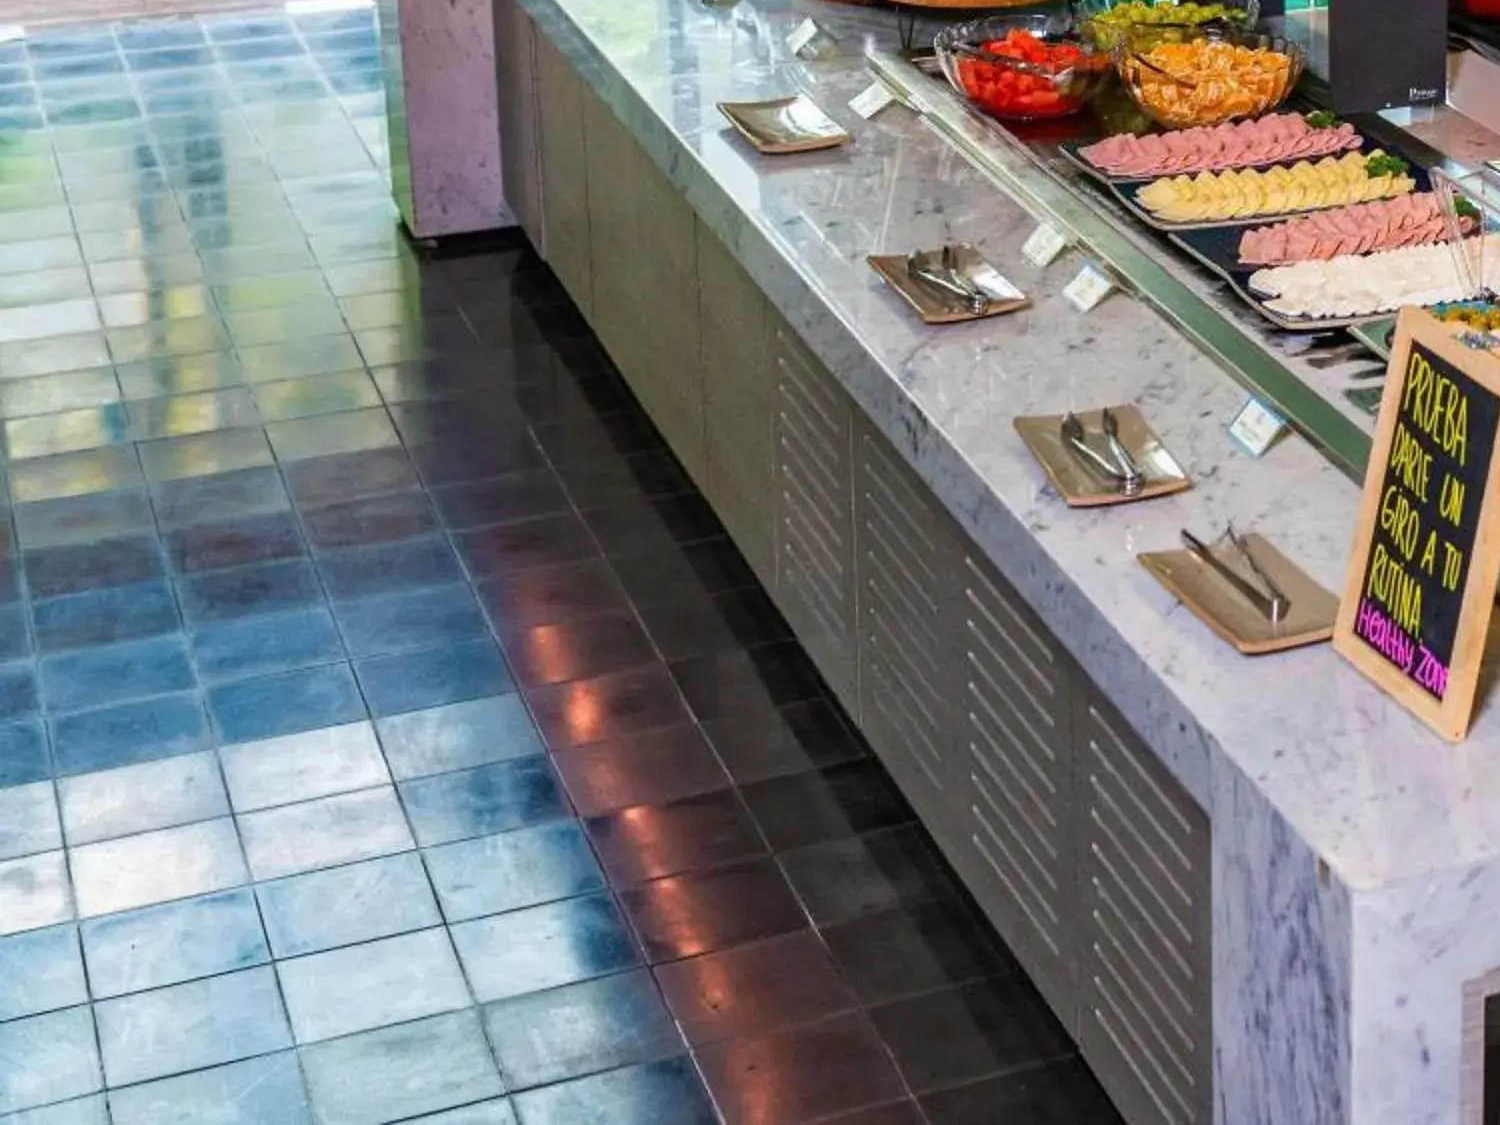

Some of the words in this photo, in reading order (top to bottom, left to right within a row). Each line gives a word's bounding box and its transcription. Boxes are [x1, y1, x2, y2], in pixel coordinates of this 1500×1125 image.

[1404, 353, 1468, 466] PRUEBA
[1391, 423, 1431, 504] DARLE
[1440, 474, 1465, 527] UN
[1420, 530, 1437, 576] A
[1442, 541, 1462, 591] TU
